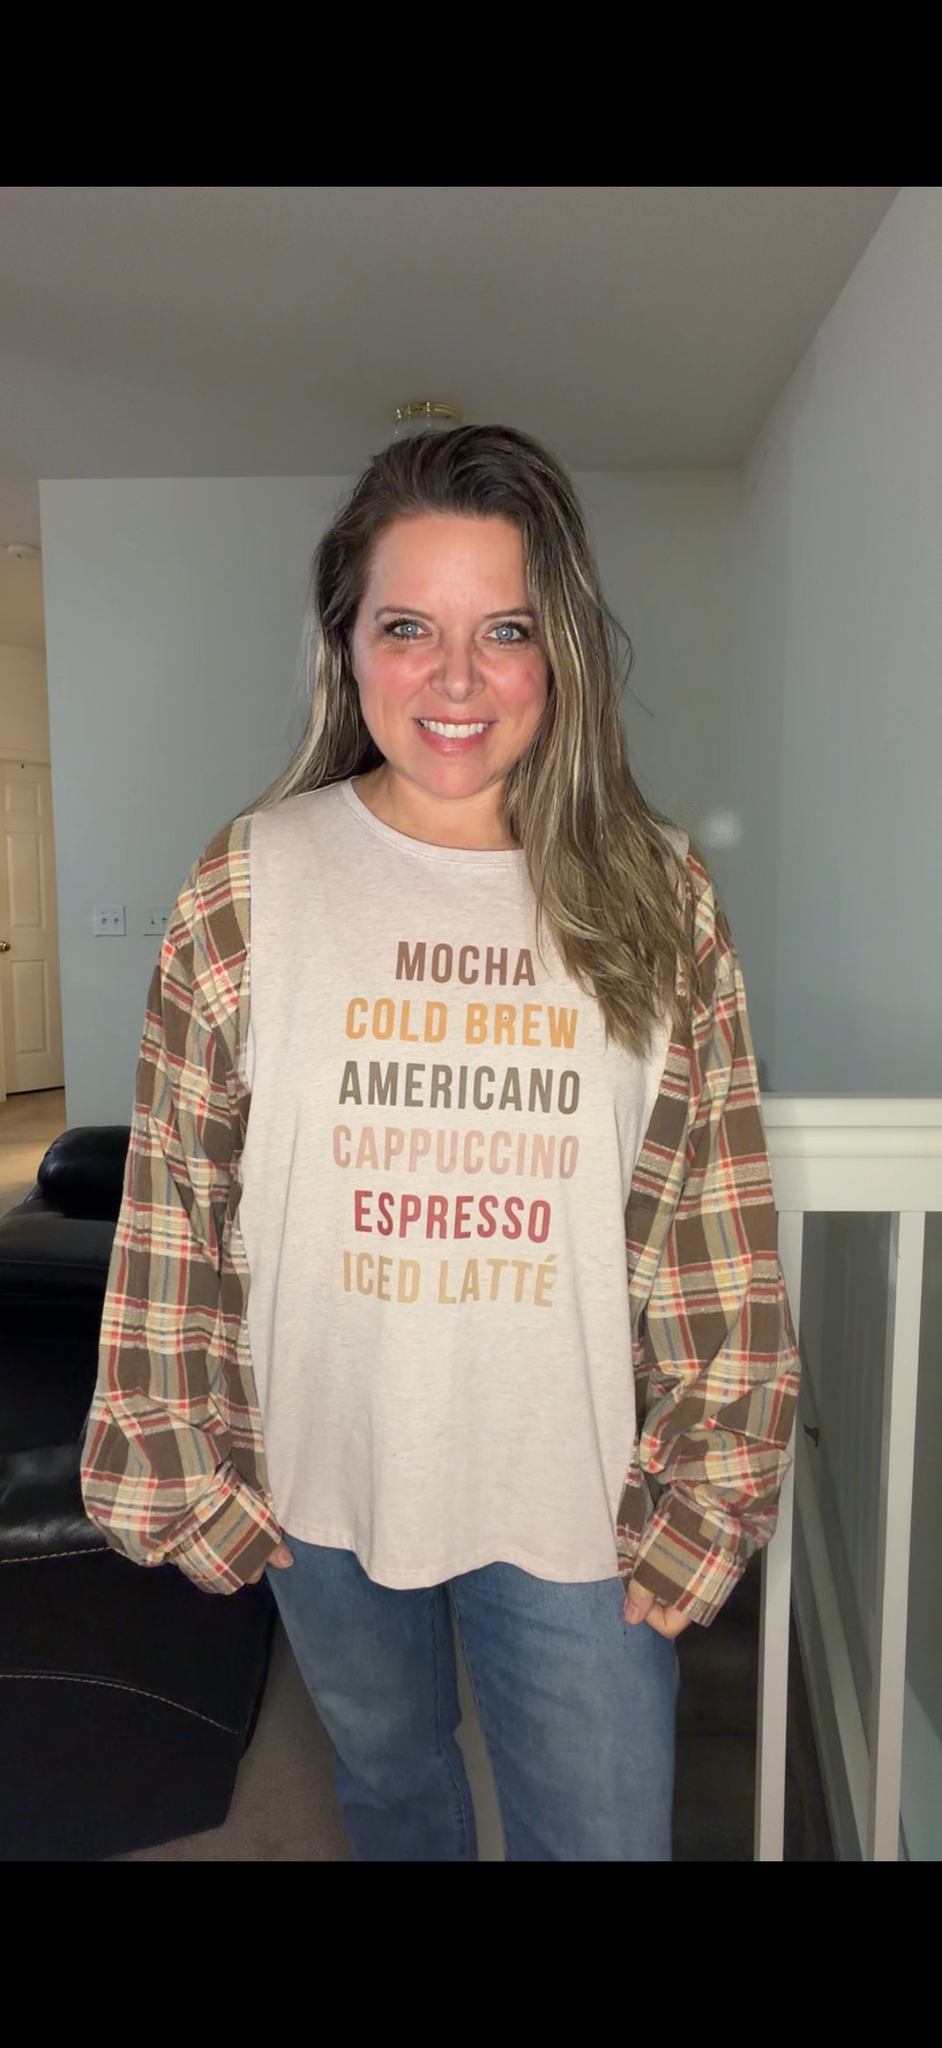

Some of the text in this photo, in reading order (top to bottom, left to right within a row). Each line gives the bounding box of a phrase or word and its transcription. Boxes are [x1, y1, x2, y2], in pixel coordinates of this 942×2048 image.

[395, 941, 536, 986] MOCHA
[345, 997, 578, 1049] COLD BREW
[339, 1060, 581, 1115] AMERICANO
[332, 1124, 580, 1179] CAPPUCCINO
[354, 1190, 551, 1243] ESPRESSO
[343, 1250, 559, 1308] ICED LATTÉ
